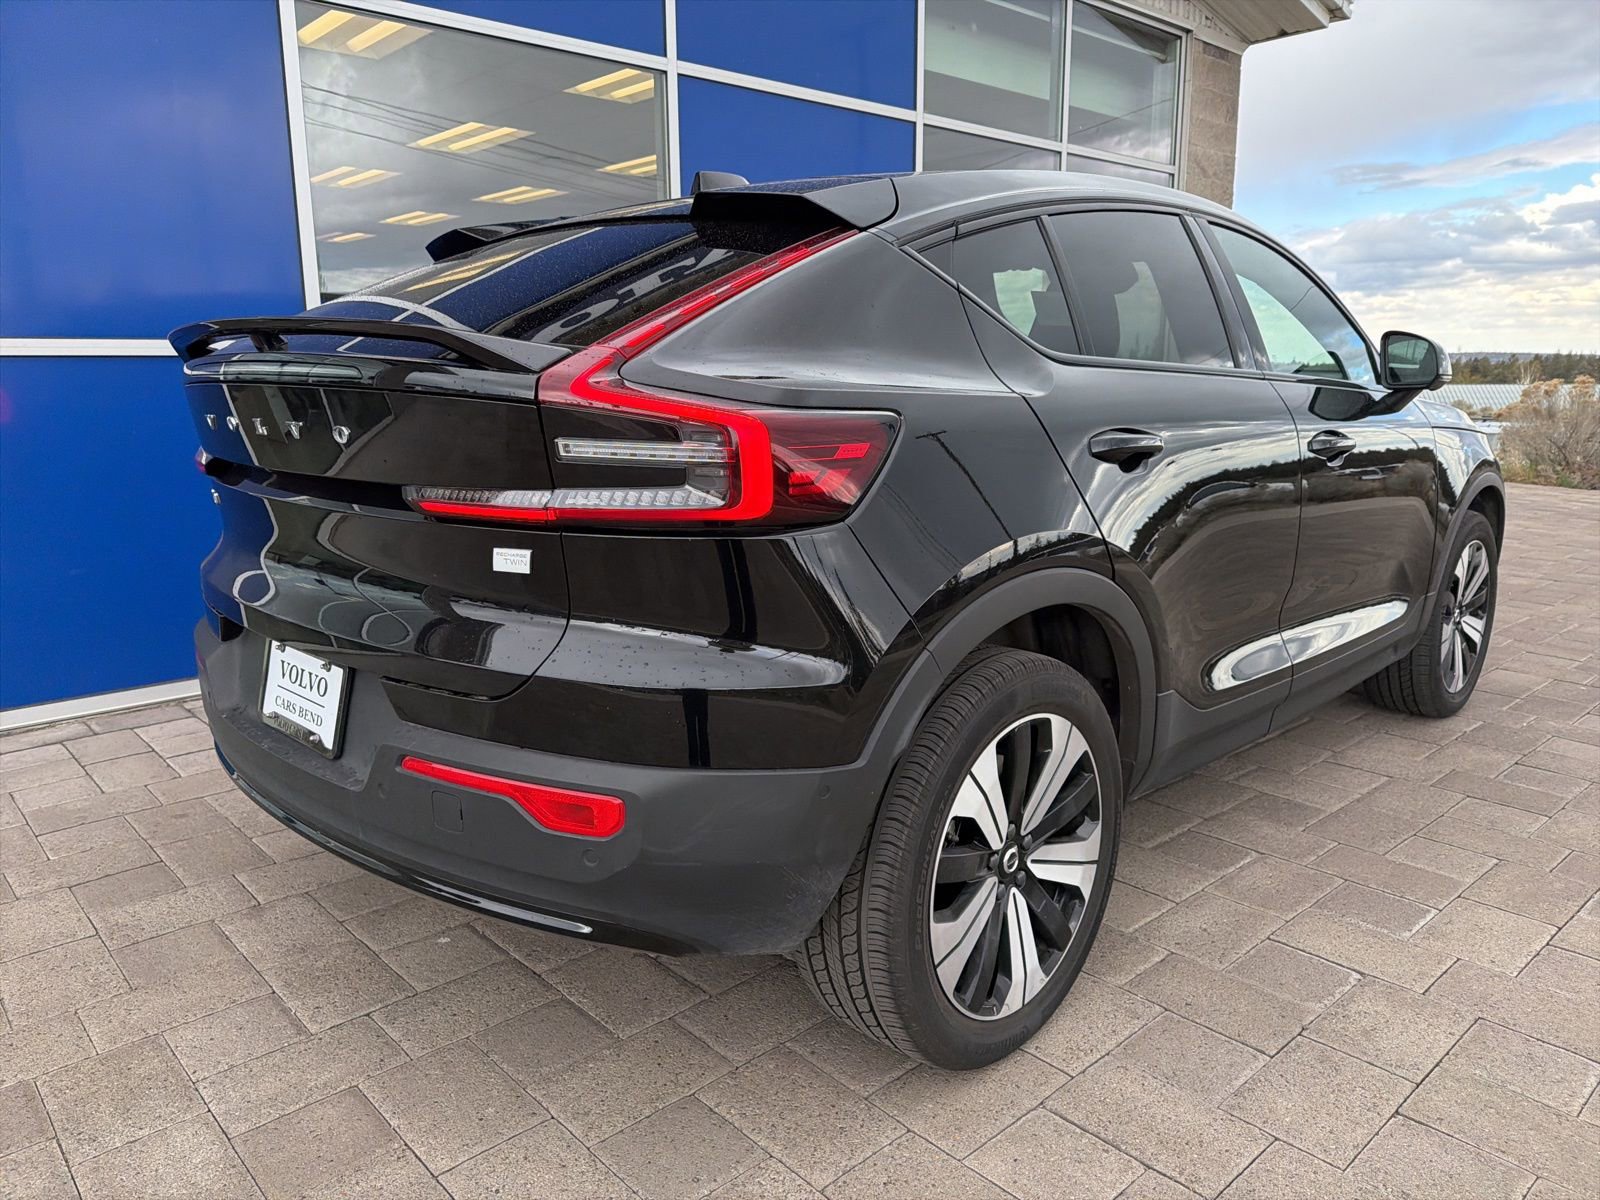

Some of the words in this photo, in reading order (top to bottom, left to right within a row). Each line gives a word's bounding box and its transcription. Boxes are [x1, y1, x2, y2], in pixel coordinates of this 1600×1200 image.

[204, 414, 351, 444] VOLVO
[495, 551, 528, 559] RECHARGE
[503, 557, 528, 567] TWIN
[280, 659, 328, 698] VOLVO
[274, 695, 297, 715] CARS
[298, 705, 323, 727] BEND
